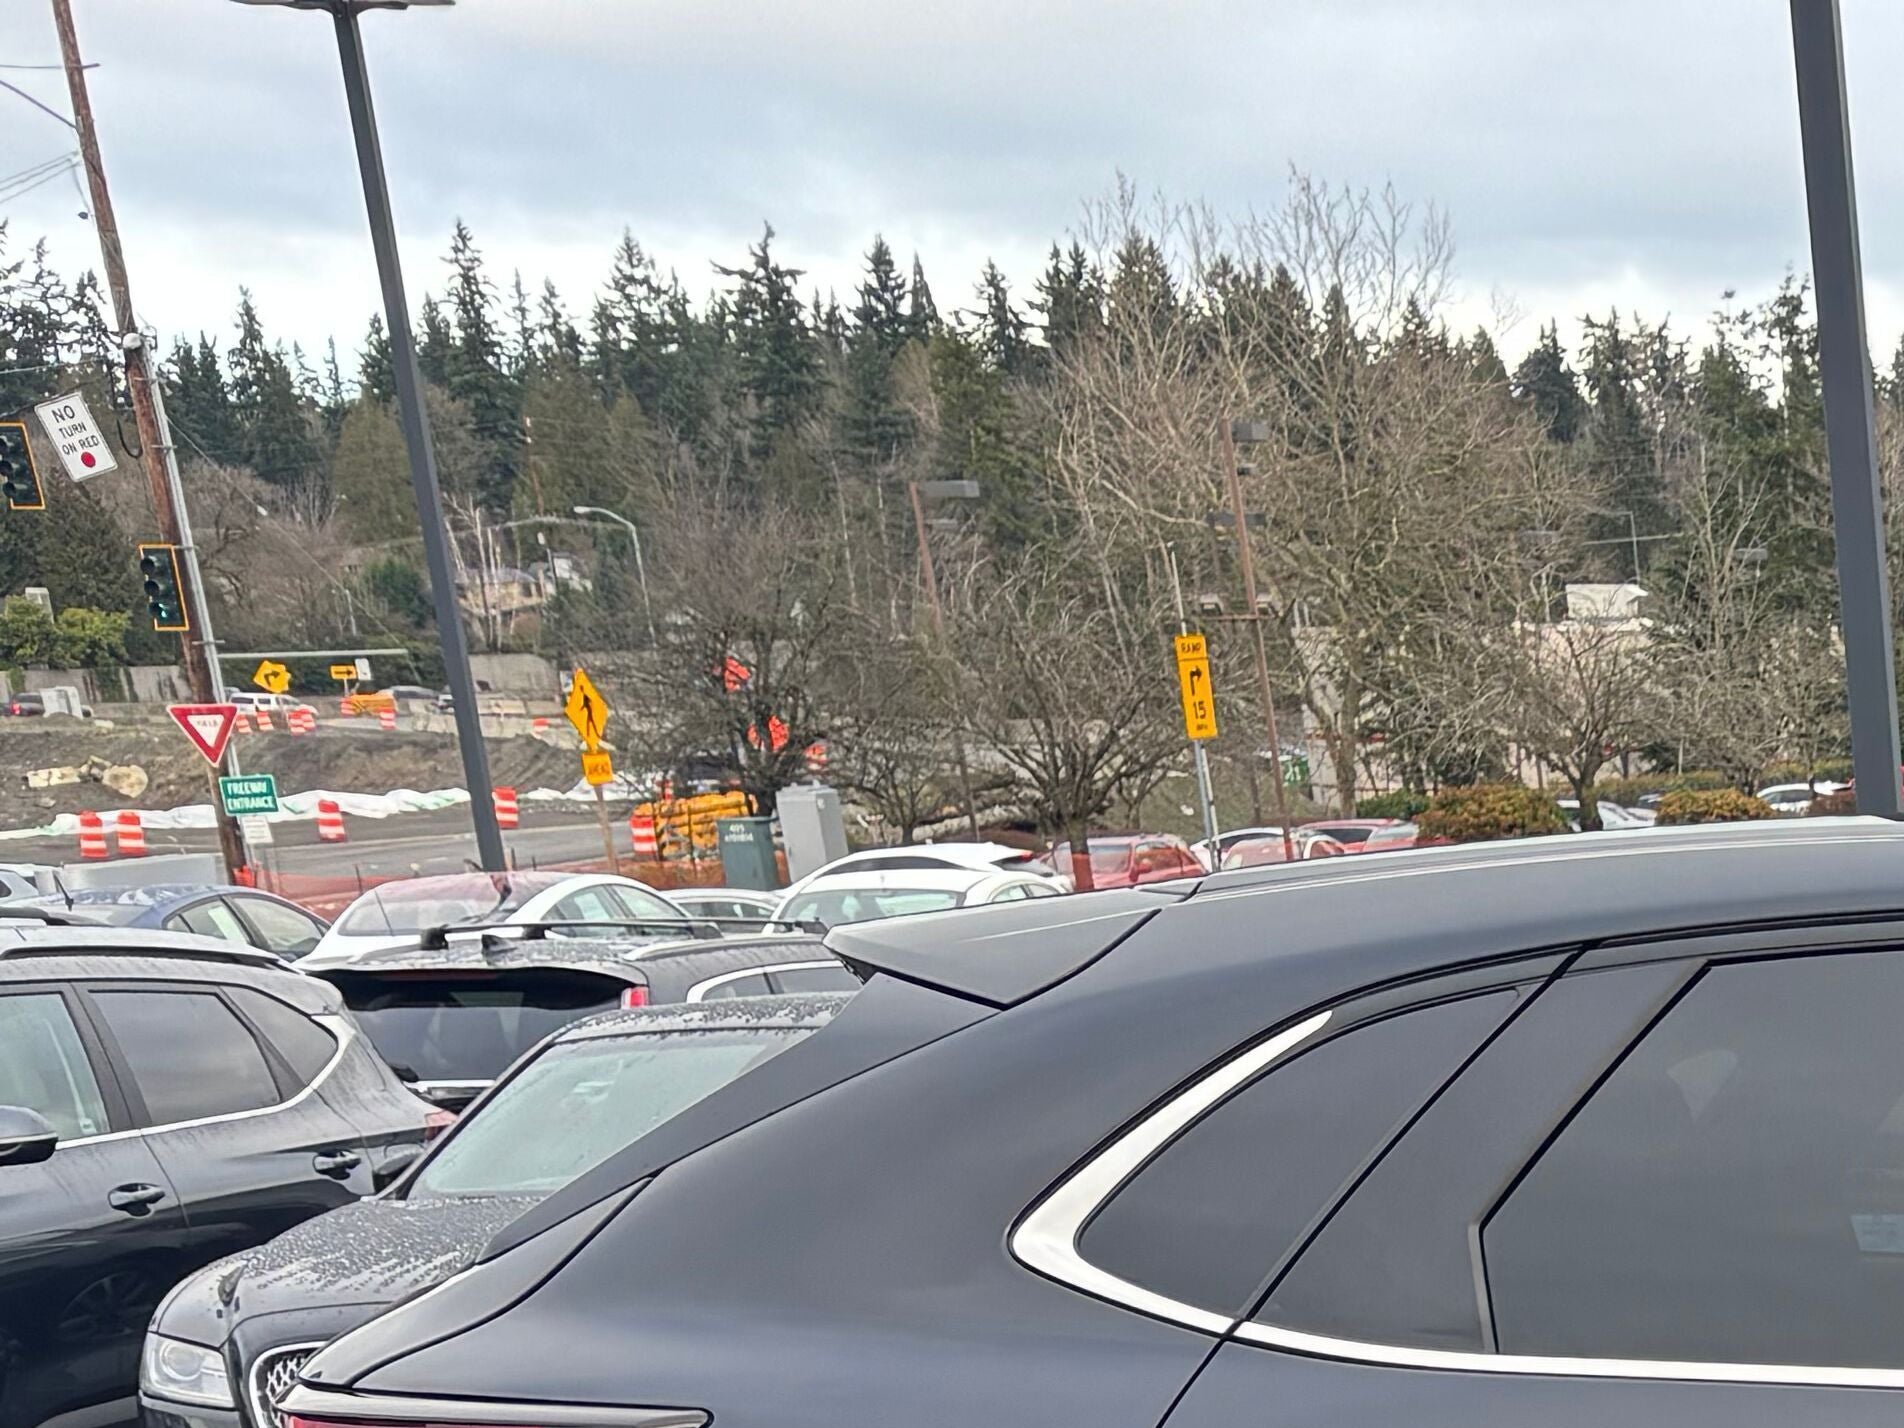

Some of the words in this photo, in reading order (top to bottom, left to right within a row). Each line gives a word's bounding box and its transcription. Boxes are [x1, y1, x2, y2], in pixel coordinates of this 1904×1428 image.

[51, 405, 75, 423] NO
[58, 421, 87, 439] TURN
[61, 442, 78, 456] ON
[78, 434, 100, 450] RED
[1193, 701, 1207, 720] 15
